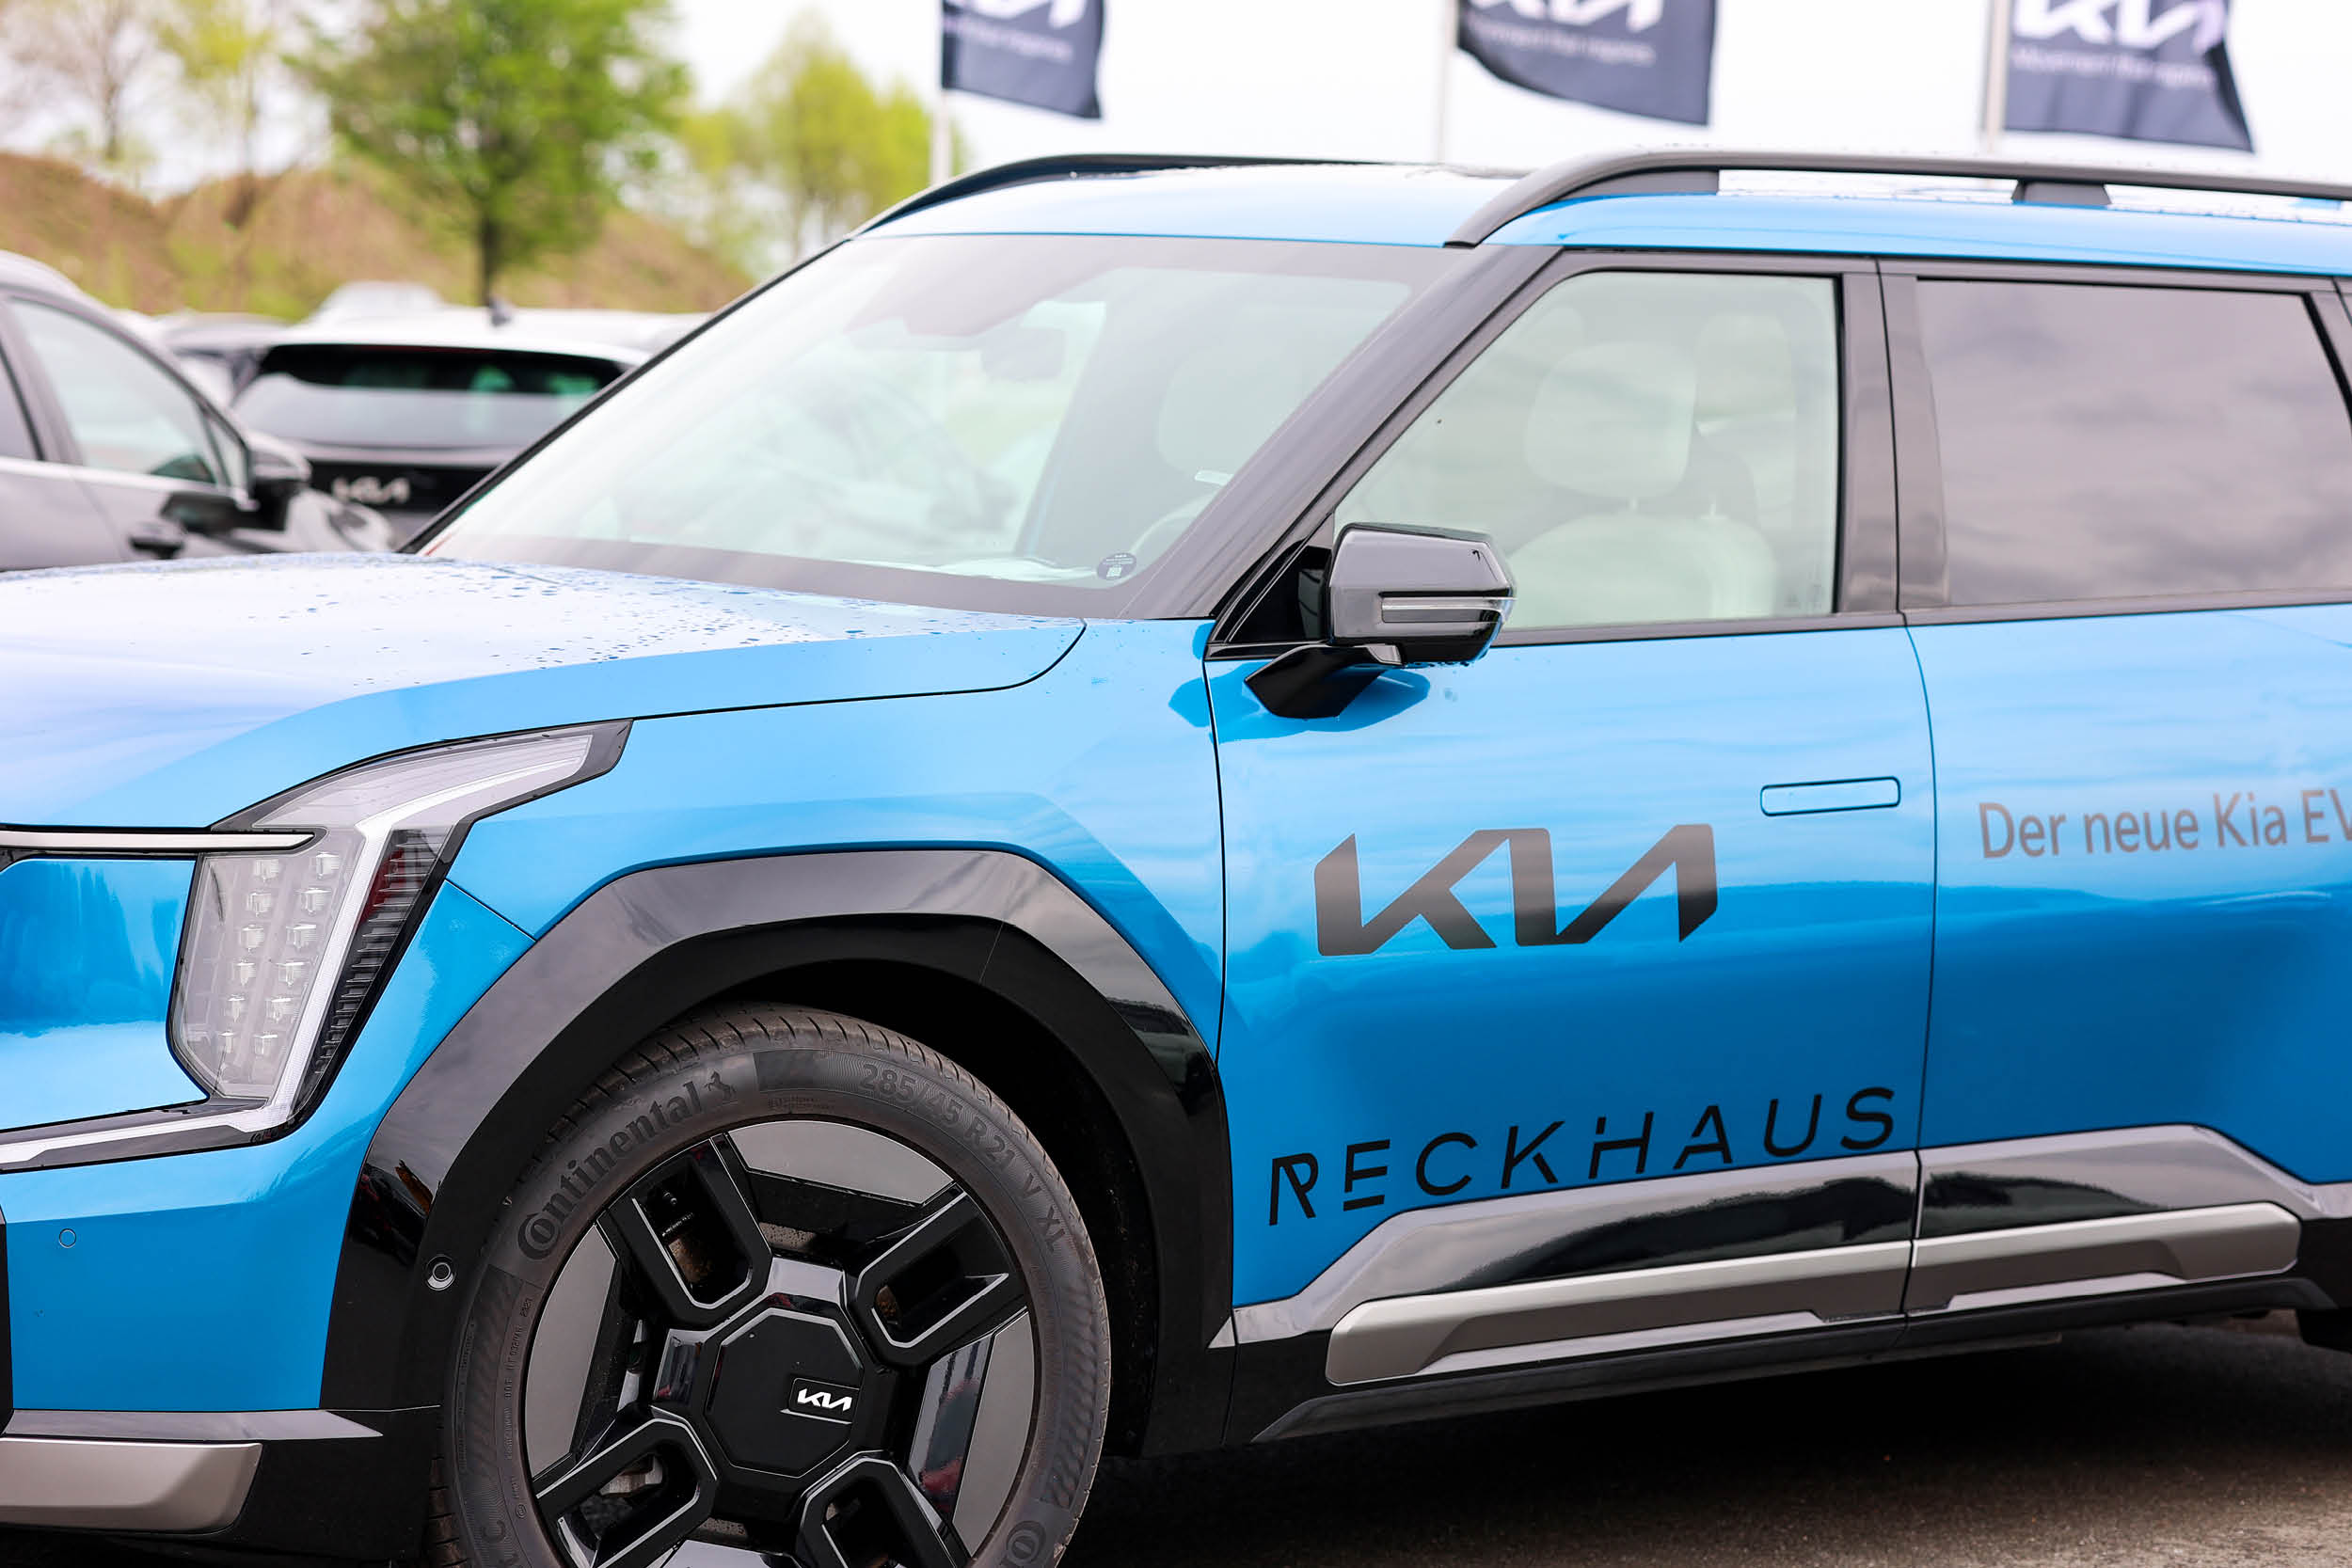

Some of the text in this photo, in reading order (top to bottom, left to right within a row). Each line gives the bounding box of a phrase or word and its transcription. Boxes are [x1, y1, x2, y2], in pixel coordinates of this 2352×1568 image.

[1979, 802, 2066, 859] Der
[2083, 808, 2199, 854] neue
[2213, 791, 2288, 847] Kia
[1314, 823, 1719, 958] KIA
[857, 1064, 963, 1126] 285/45
[518, 1081, 702, 1260] Continental
[1268, 1087, 1896, 1227] RECKHAUS
[797, 1388, 852, 1412] KIA
